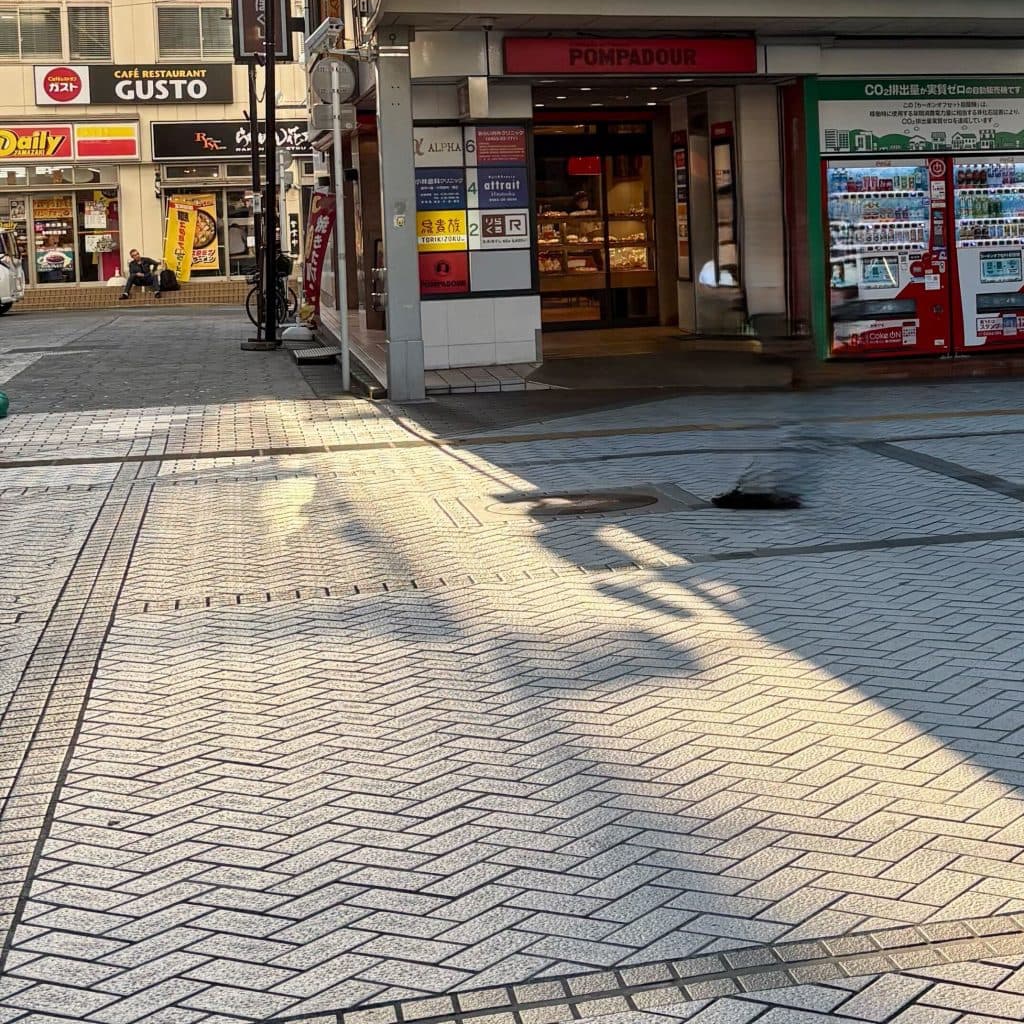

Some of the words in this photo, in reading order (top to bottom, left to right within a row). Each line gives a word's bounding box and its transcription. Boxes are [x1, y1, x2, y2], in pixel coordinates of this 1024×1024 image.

[569, 48, 697, 66] POMPADOUR
[113, 67, 139, 78] CAFÉ
[142, 69, 207, 79] RESTAURANT
[48, 82, 79, 93] ガスト
[114, 79, 208, 100] GUSTO
[0, 129, 65, 156] Daily
[428, 142, 462, 154] ALPHA
[465, 139, 475, 153] 6
[467, 182, 477, 195] 4
[484, 180, 520, 190] attrait
[469, 223, 479, 236] 2
